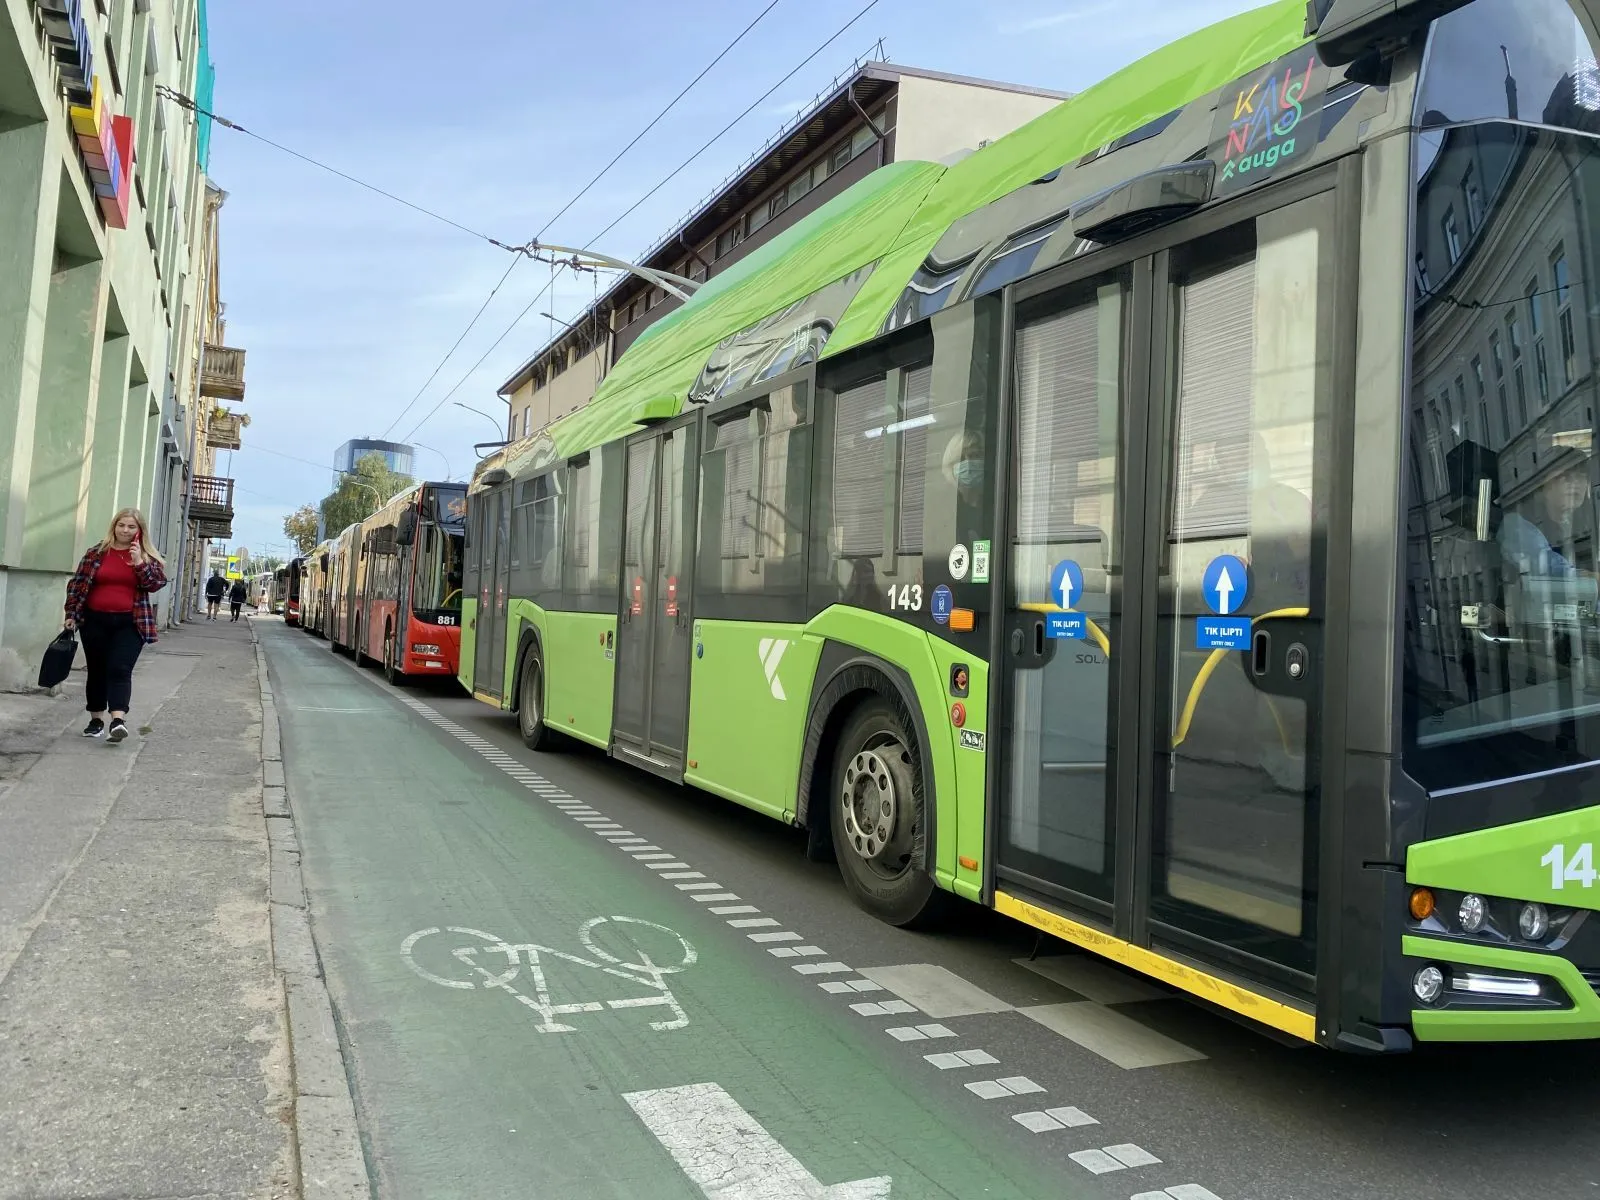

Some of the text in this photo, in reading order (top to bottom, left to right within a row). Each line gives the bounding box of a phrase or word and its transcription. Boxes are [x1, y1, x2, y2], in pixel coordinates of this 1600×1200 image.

[1238, 138, 1296, 172] auga
[887, 584, 922, 611] 143
[437, 615, 455, 625] 881
[1052, 620, 1063, 628] TIK
[1204, 627, 1218, 635] TIK
[1540, 842, 1600, 890] 14
